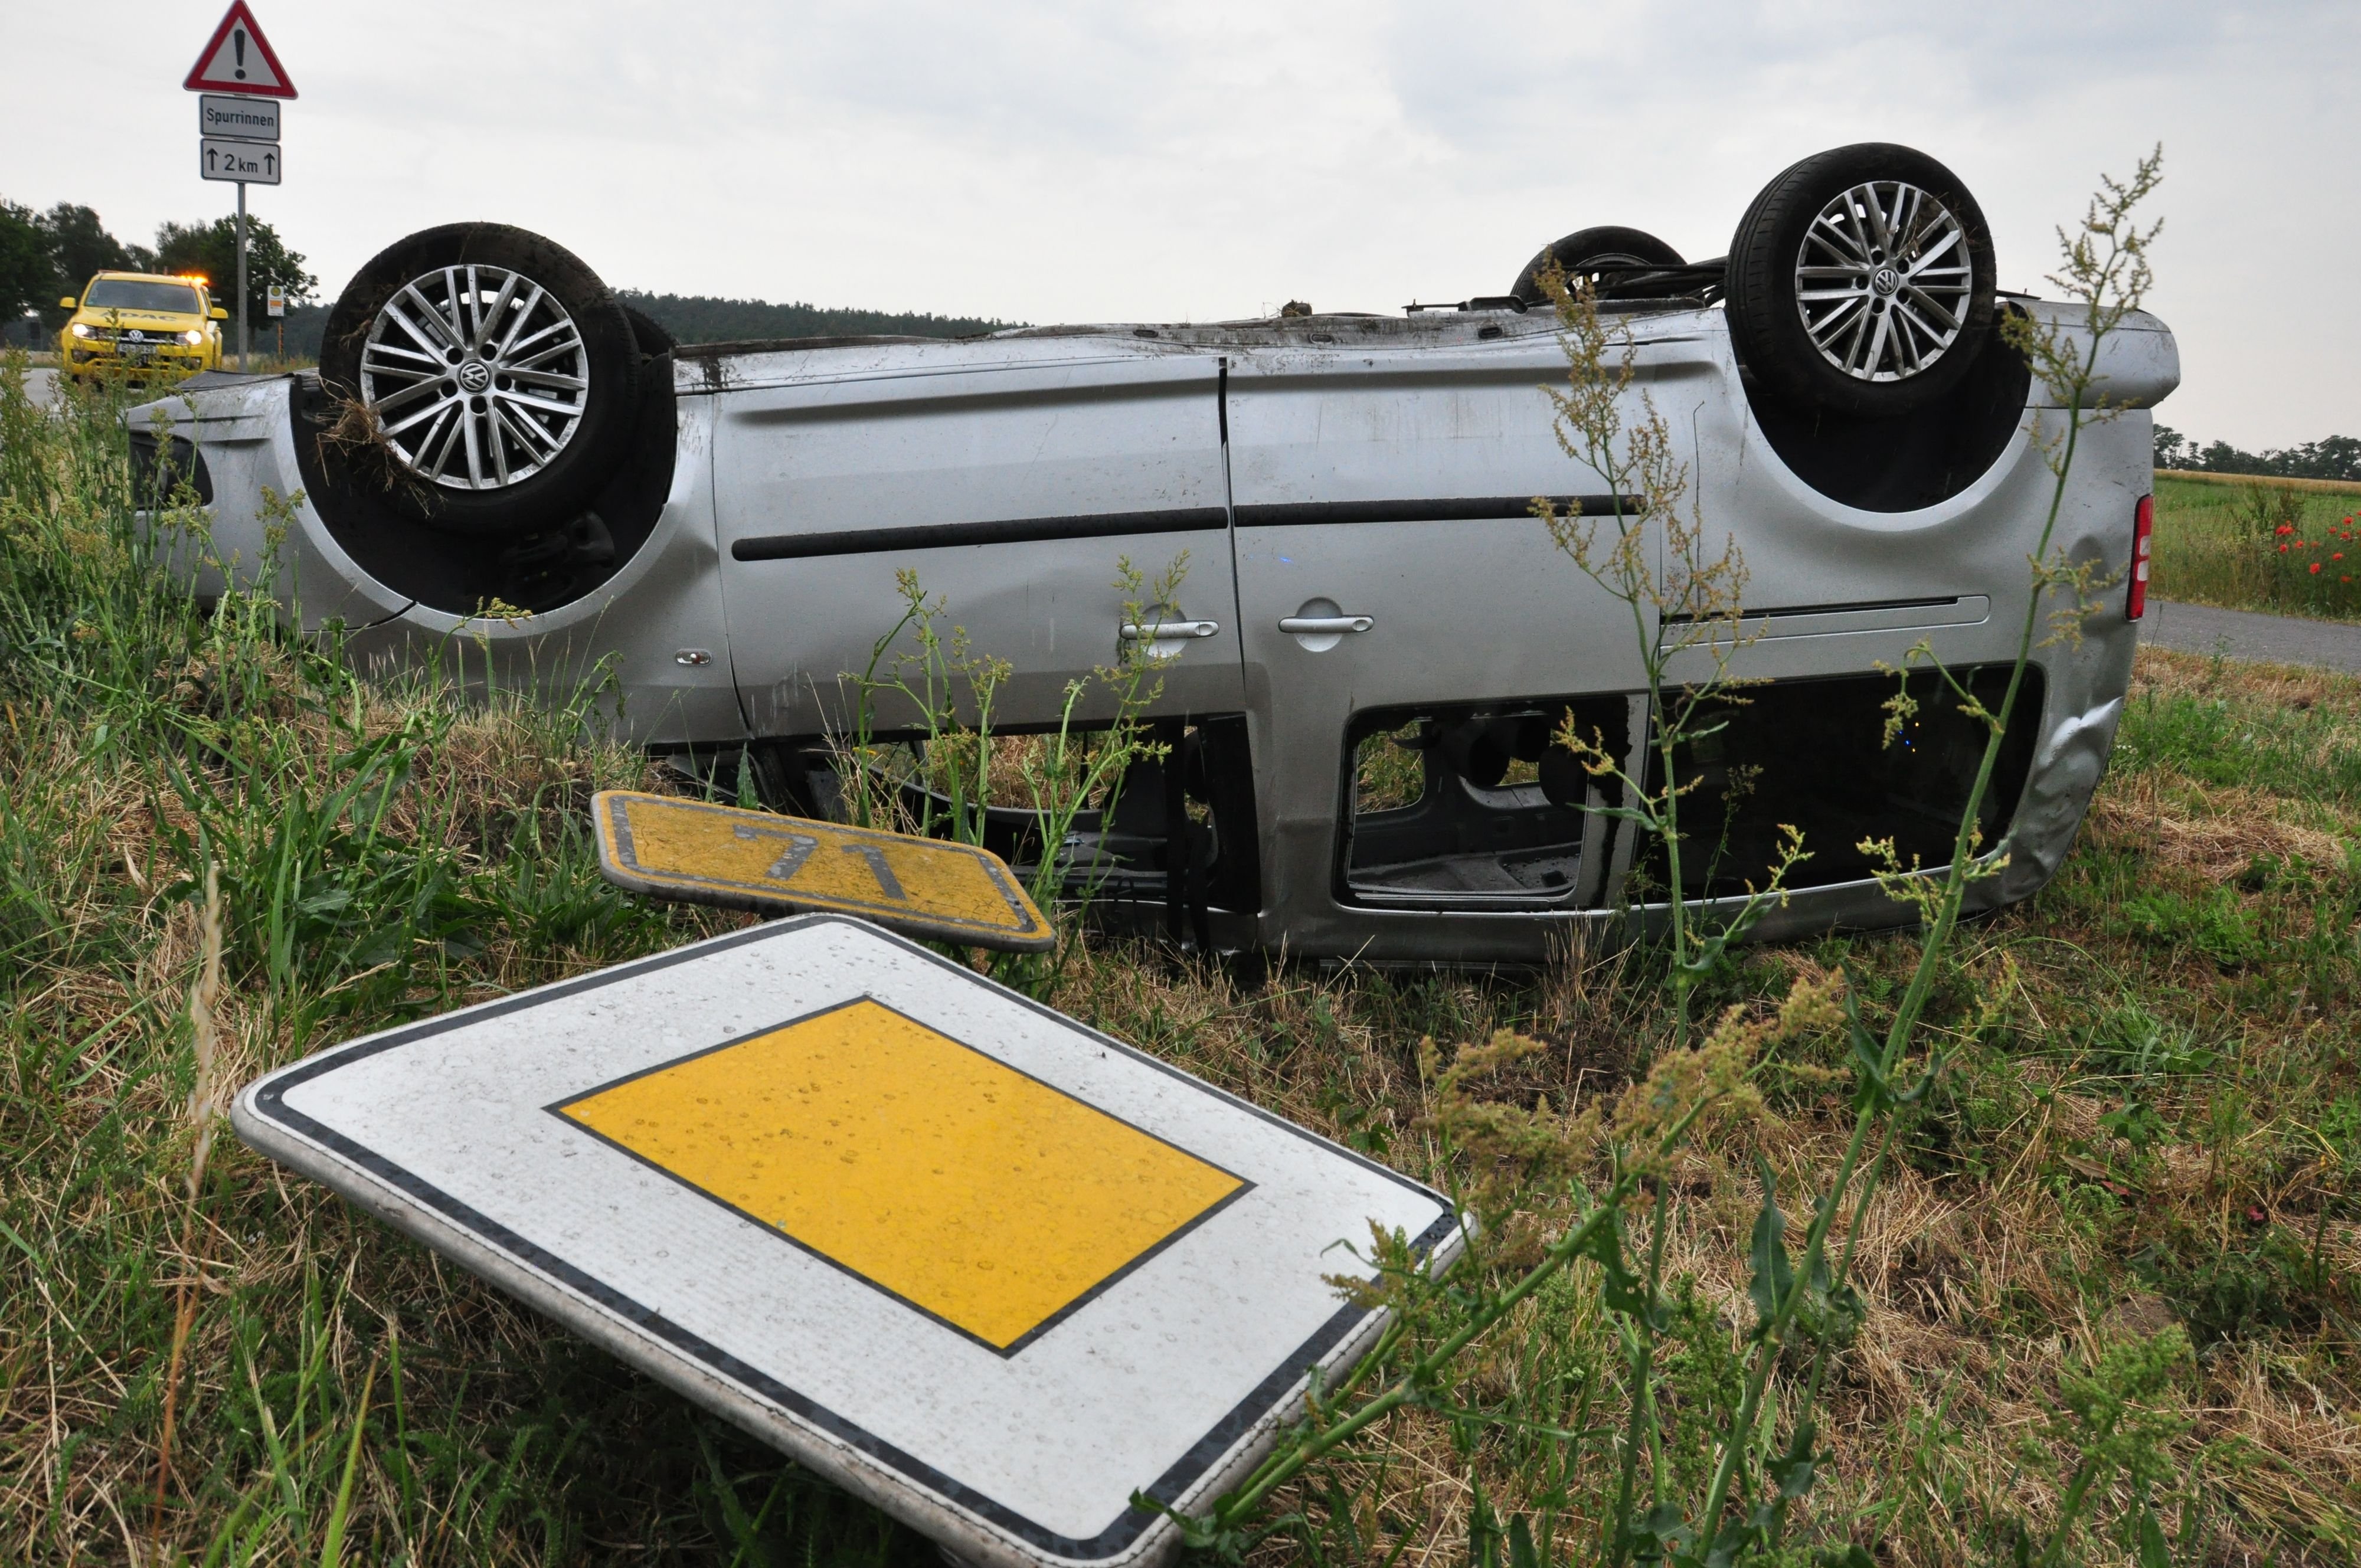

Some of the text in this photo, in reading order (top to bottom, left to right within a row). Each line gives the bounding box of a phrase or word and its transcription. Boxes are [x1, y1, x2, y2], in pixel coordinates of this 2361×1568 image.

[207, 107, 274, 127] Spurrinnen
[224, 153, 258, 173] 2 km
[733, 824, 907, 901] 71
